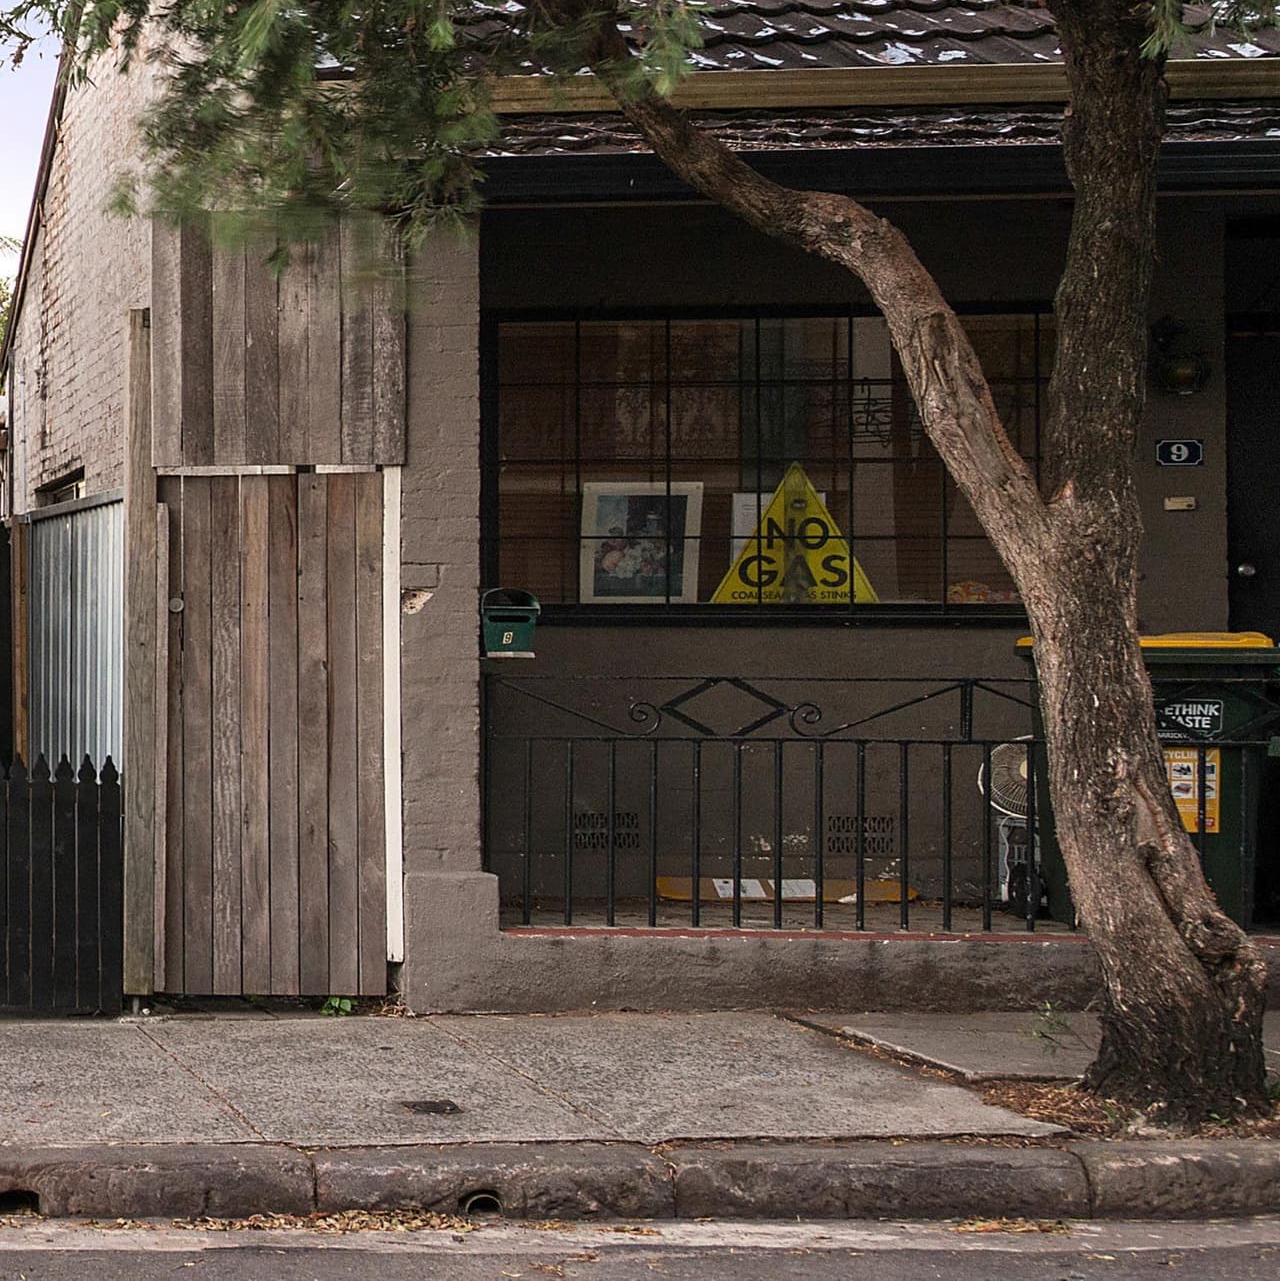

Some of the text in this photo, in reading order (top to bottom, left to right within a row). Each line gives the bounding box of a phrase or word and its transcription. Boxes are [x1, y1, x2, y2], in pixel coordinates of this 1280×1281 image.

[1170, 443, 1189, 462] 9
[767, 517, 829, 550] NO
[738, 554, 848, 587] GAS
[763, 590, 792, 599] SEA
[1160, 703, 1220, 716] ETHINK
[1160, 715, 1211, 728] ASTE
